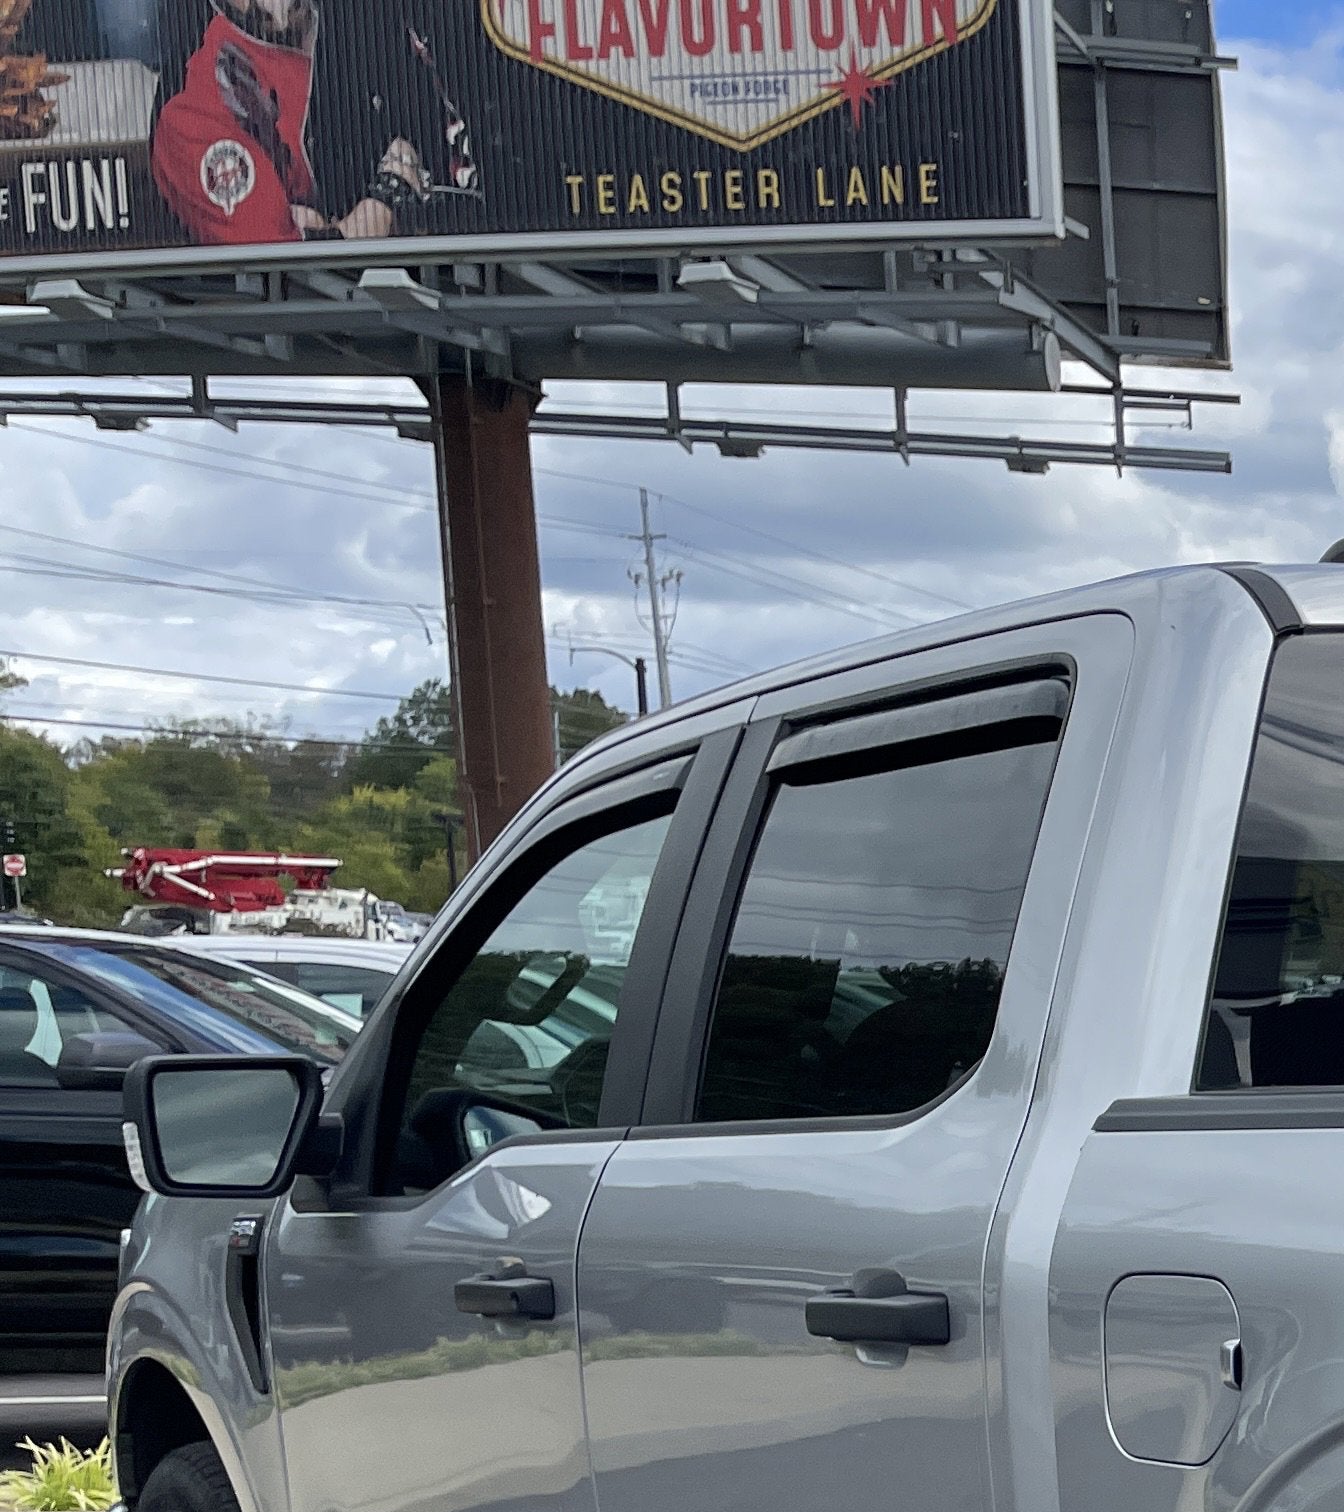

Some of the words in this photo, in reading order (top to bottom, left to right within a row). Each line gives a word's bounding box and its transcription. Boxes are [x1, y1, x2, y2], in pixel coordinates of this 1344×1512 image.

[22, 157, 129, 233] FUN!
[565, 169, 780, 217] TEASTER
[816, 163, 939, 207] LANE
